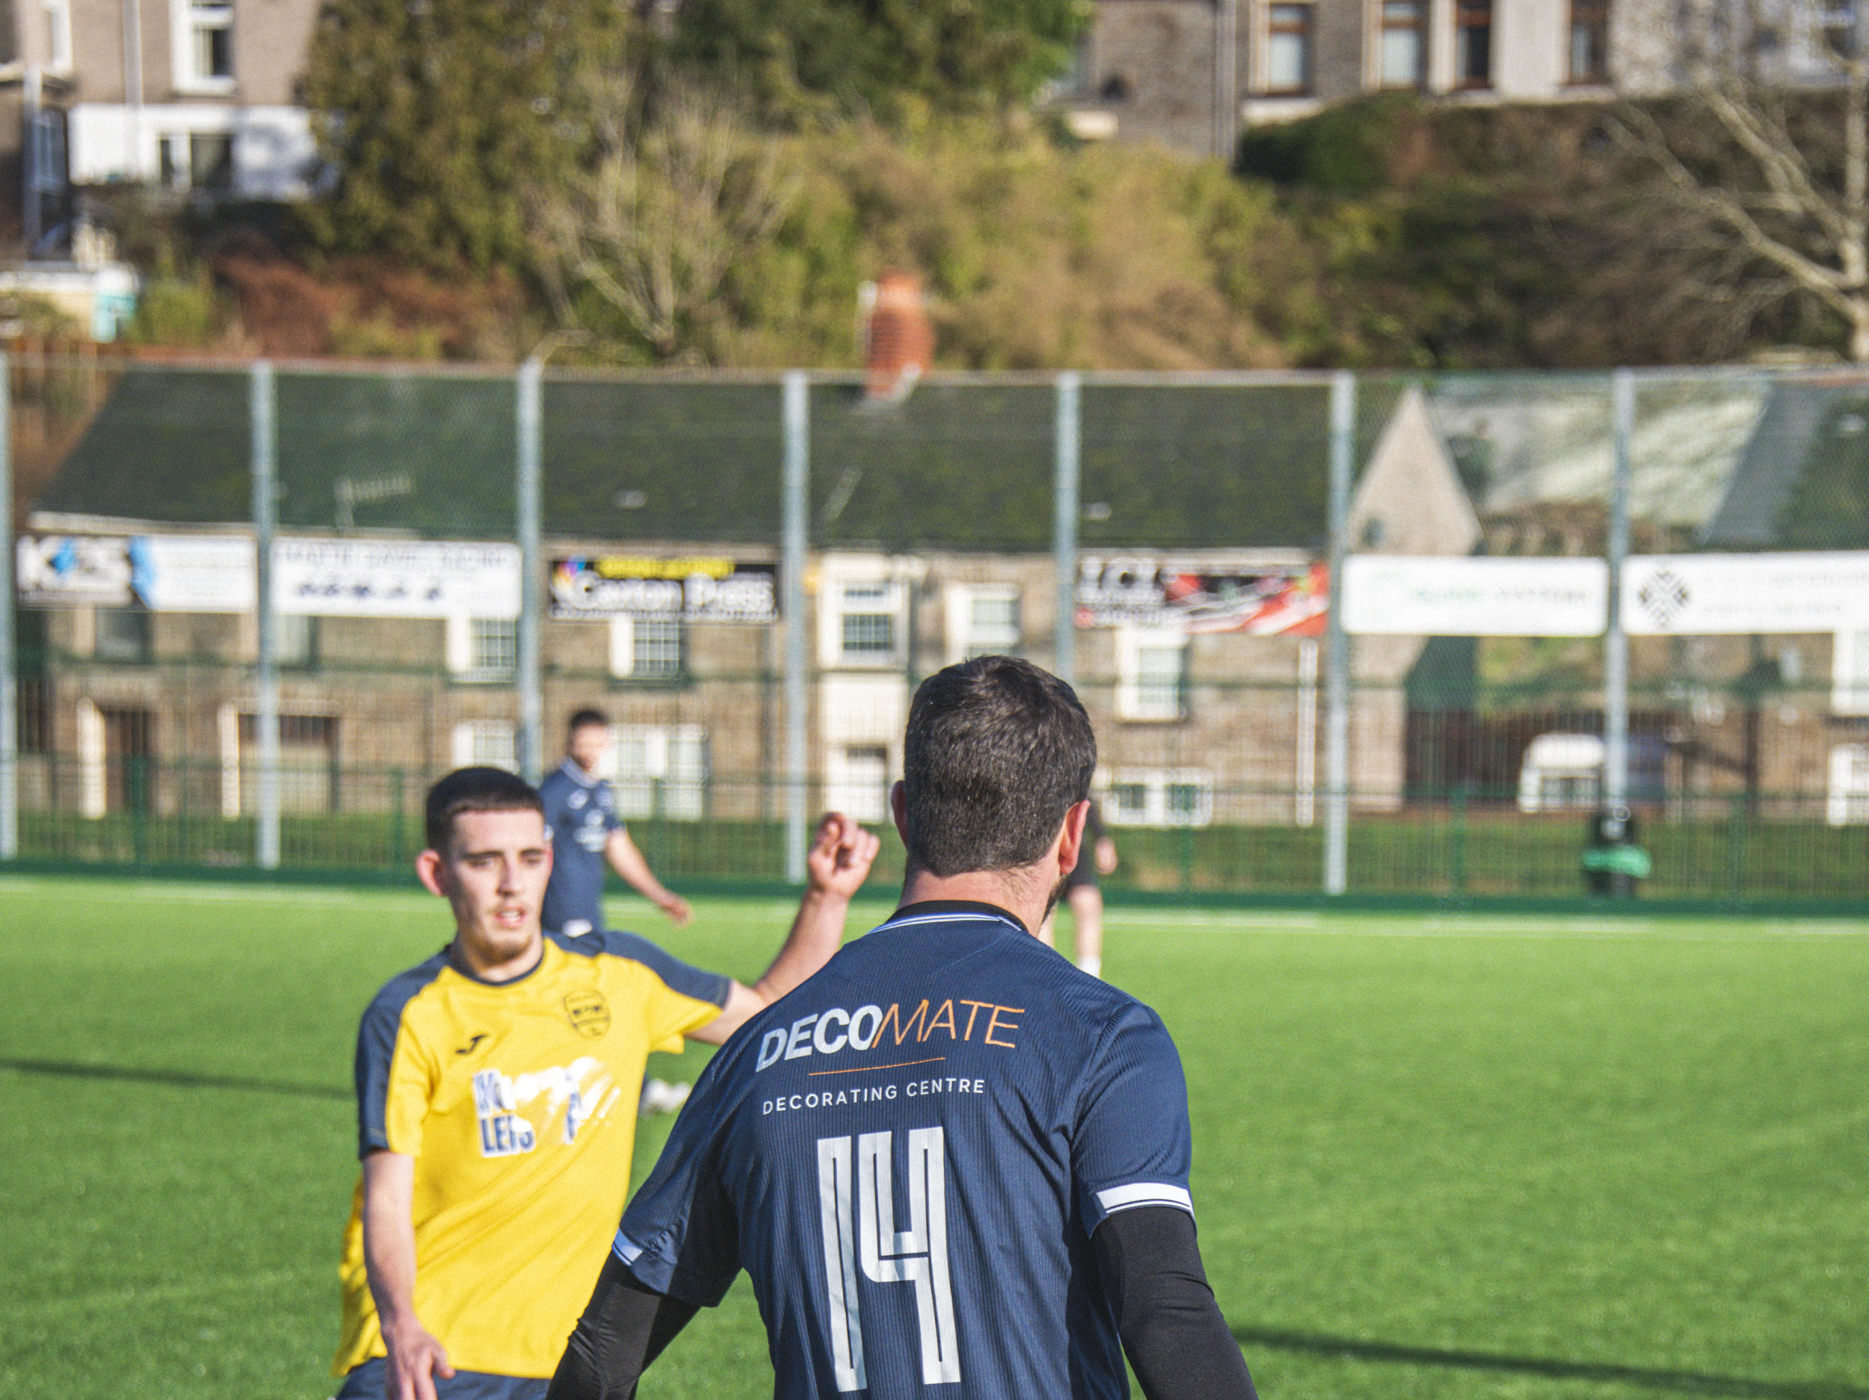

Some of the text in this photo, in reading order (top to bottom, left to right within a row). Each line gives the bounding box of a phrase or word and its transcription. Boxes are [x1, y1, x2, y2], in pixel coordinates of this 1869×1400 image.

[756, 999, 1025, 1073] DECOMATE
[762, 1077, 985, 1116] DECORATING CENTRE
[817, 1126, 961, 1392] 14
